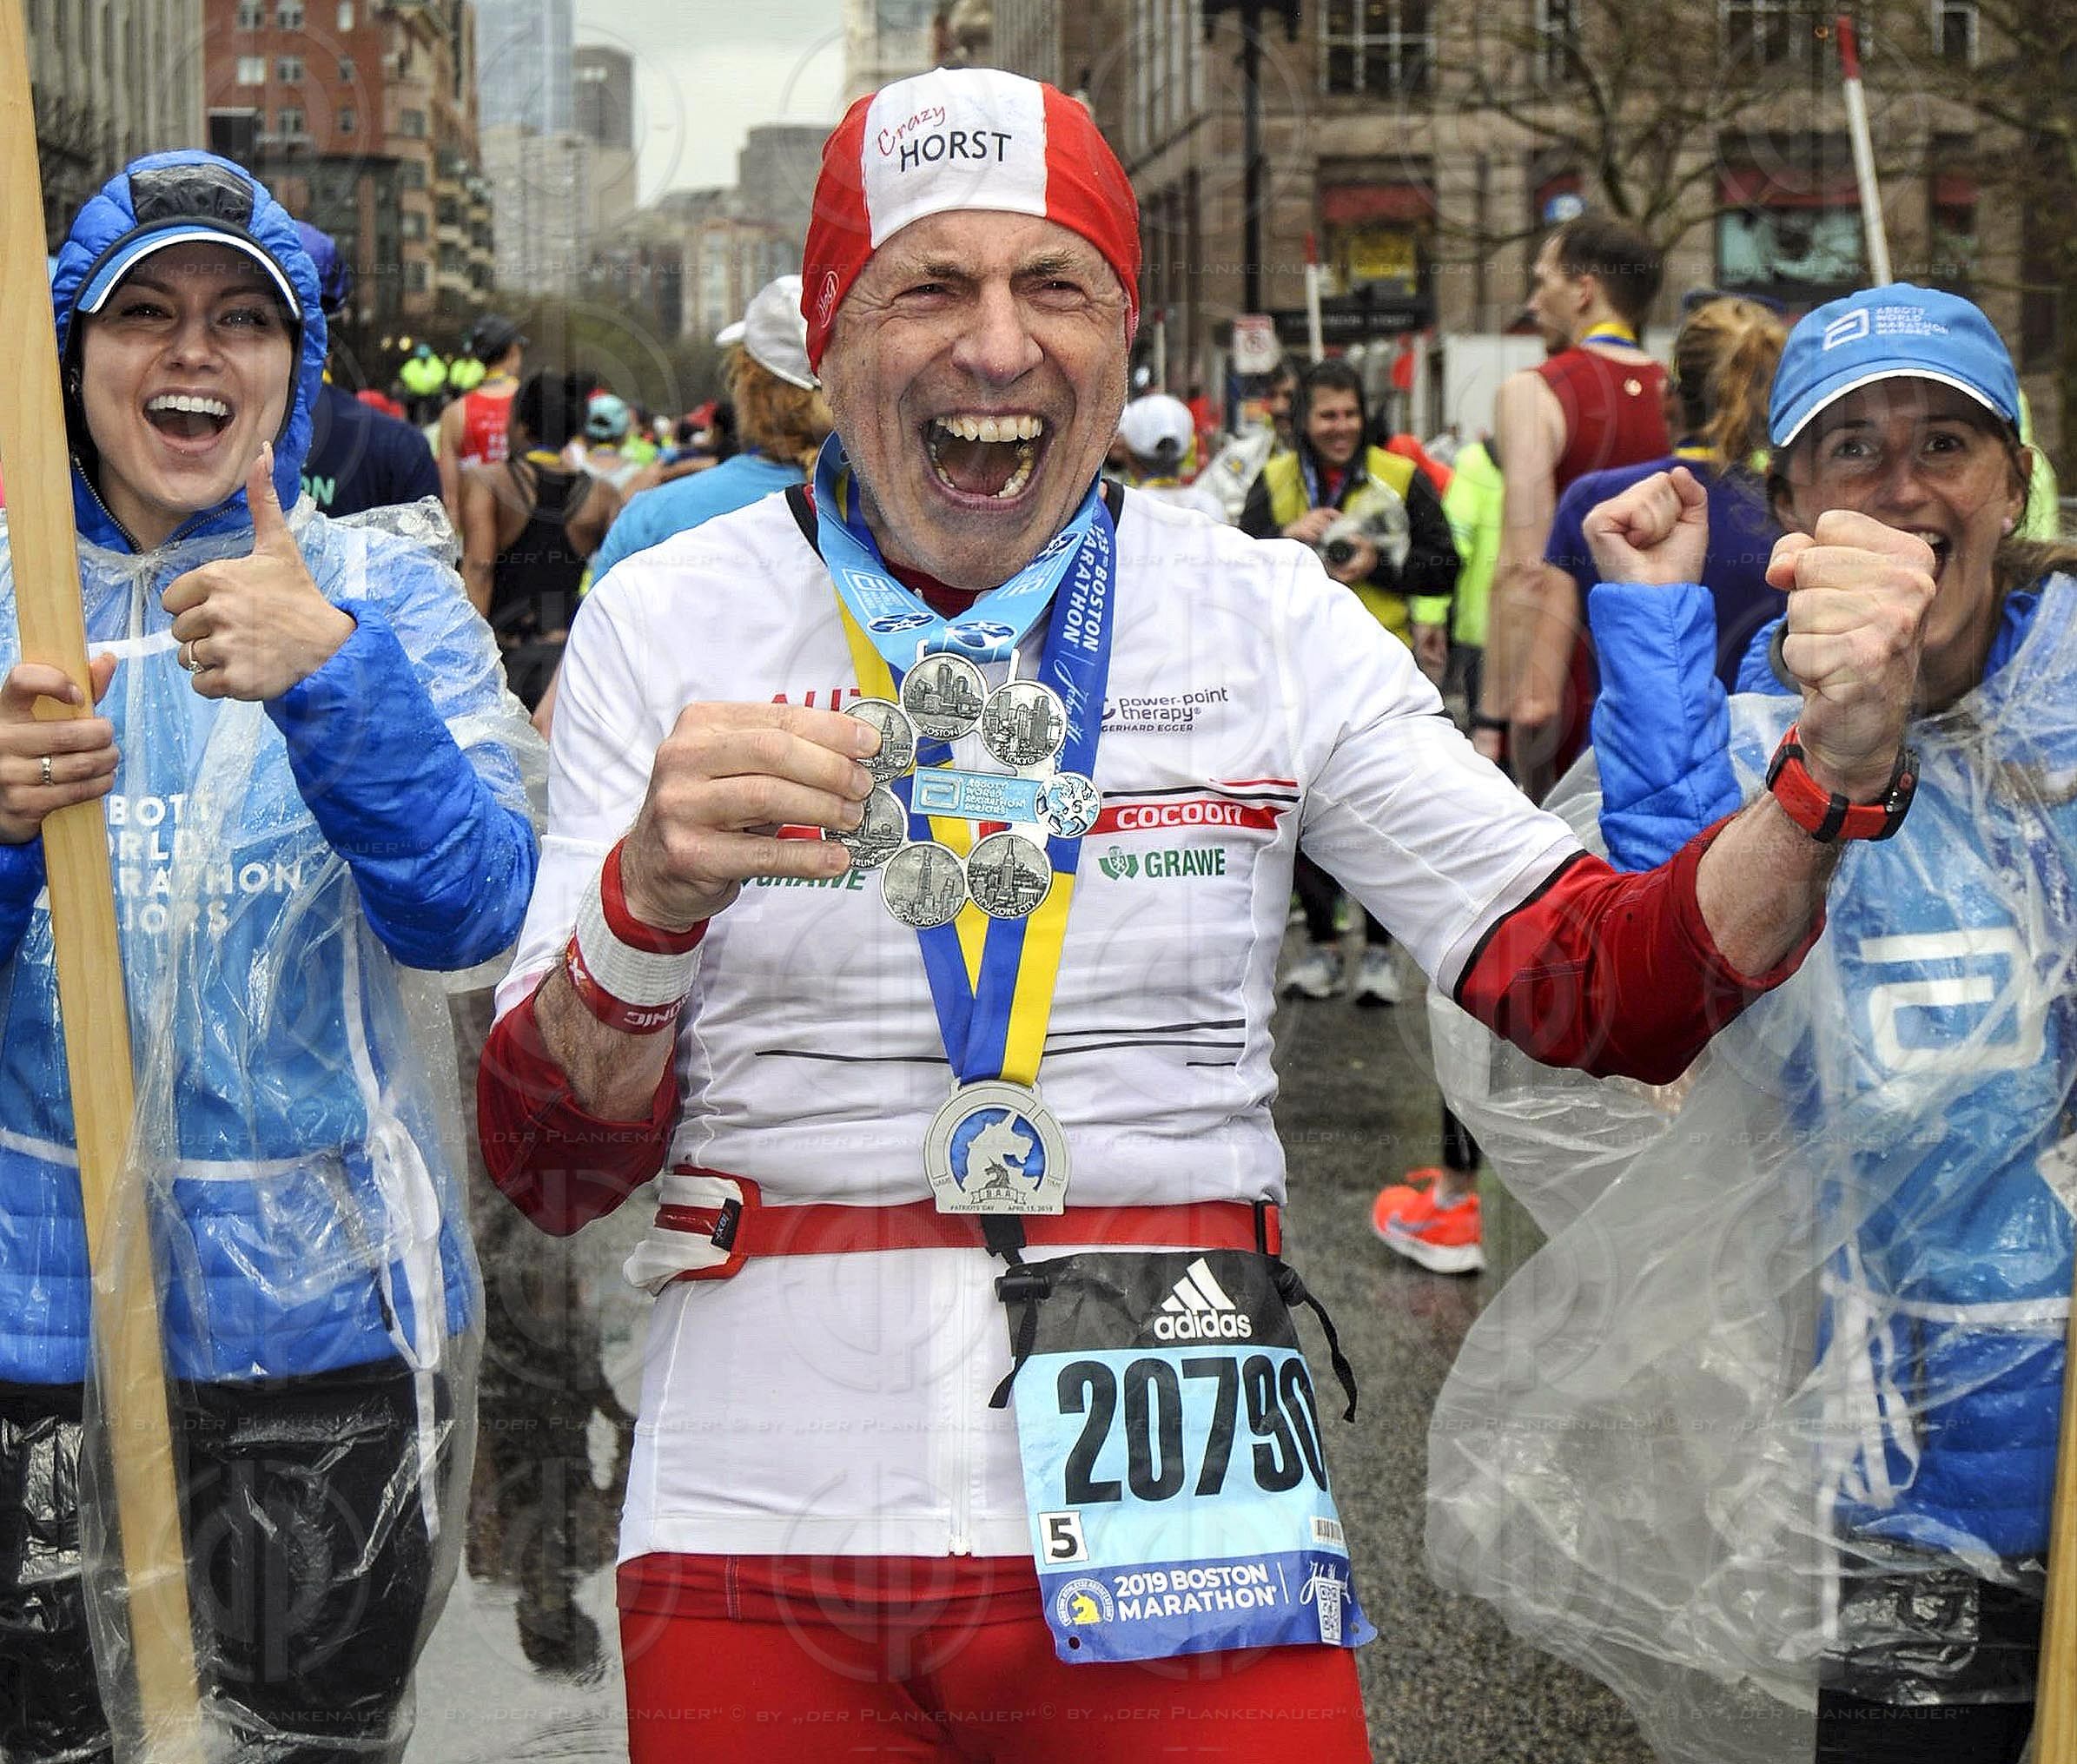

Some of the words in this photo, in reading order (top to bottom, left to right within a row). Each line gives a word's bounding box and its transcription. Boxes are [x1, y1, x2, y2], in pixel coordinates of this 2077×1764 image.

[877, 106, 946, 156] Crazy
[900, 130, 1012, 173] HORST
[1082, 565, 1108, 653] BOSTON
[1006, 752, 1035, 764] TOKYO
[1144, 848, 1225, 878] GRAWE
[899, 913, 942, 925] CHICAGO
[1154, 1308, 1252, 1340] adidas
[1056, 1355, 1328, 1505] 20790
[1049, 1517, 1078, 1558] 5
[1115, 1569, 1169, 1598] 2019
[1170, 1563, 1269, 1592] BOSTON
[1119, 1585, 1279, 1623] MARATHON
